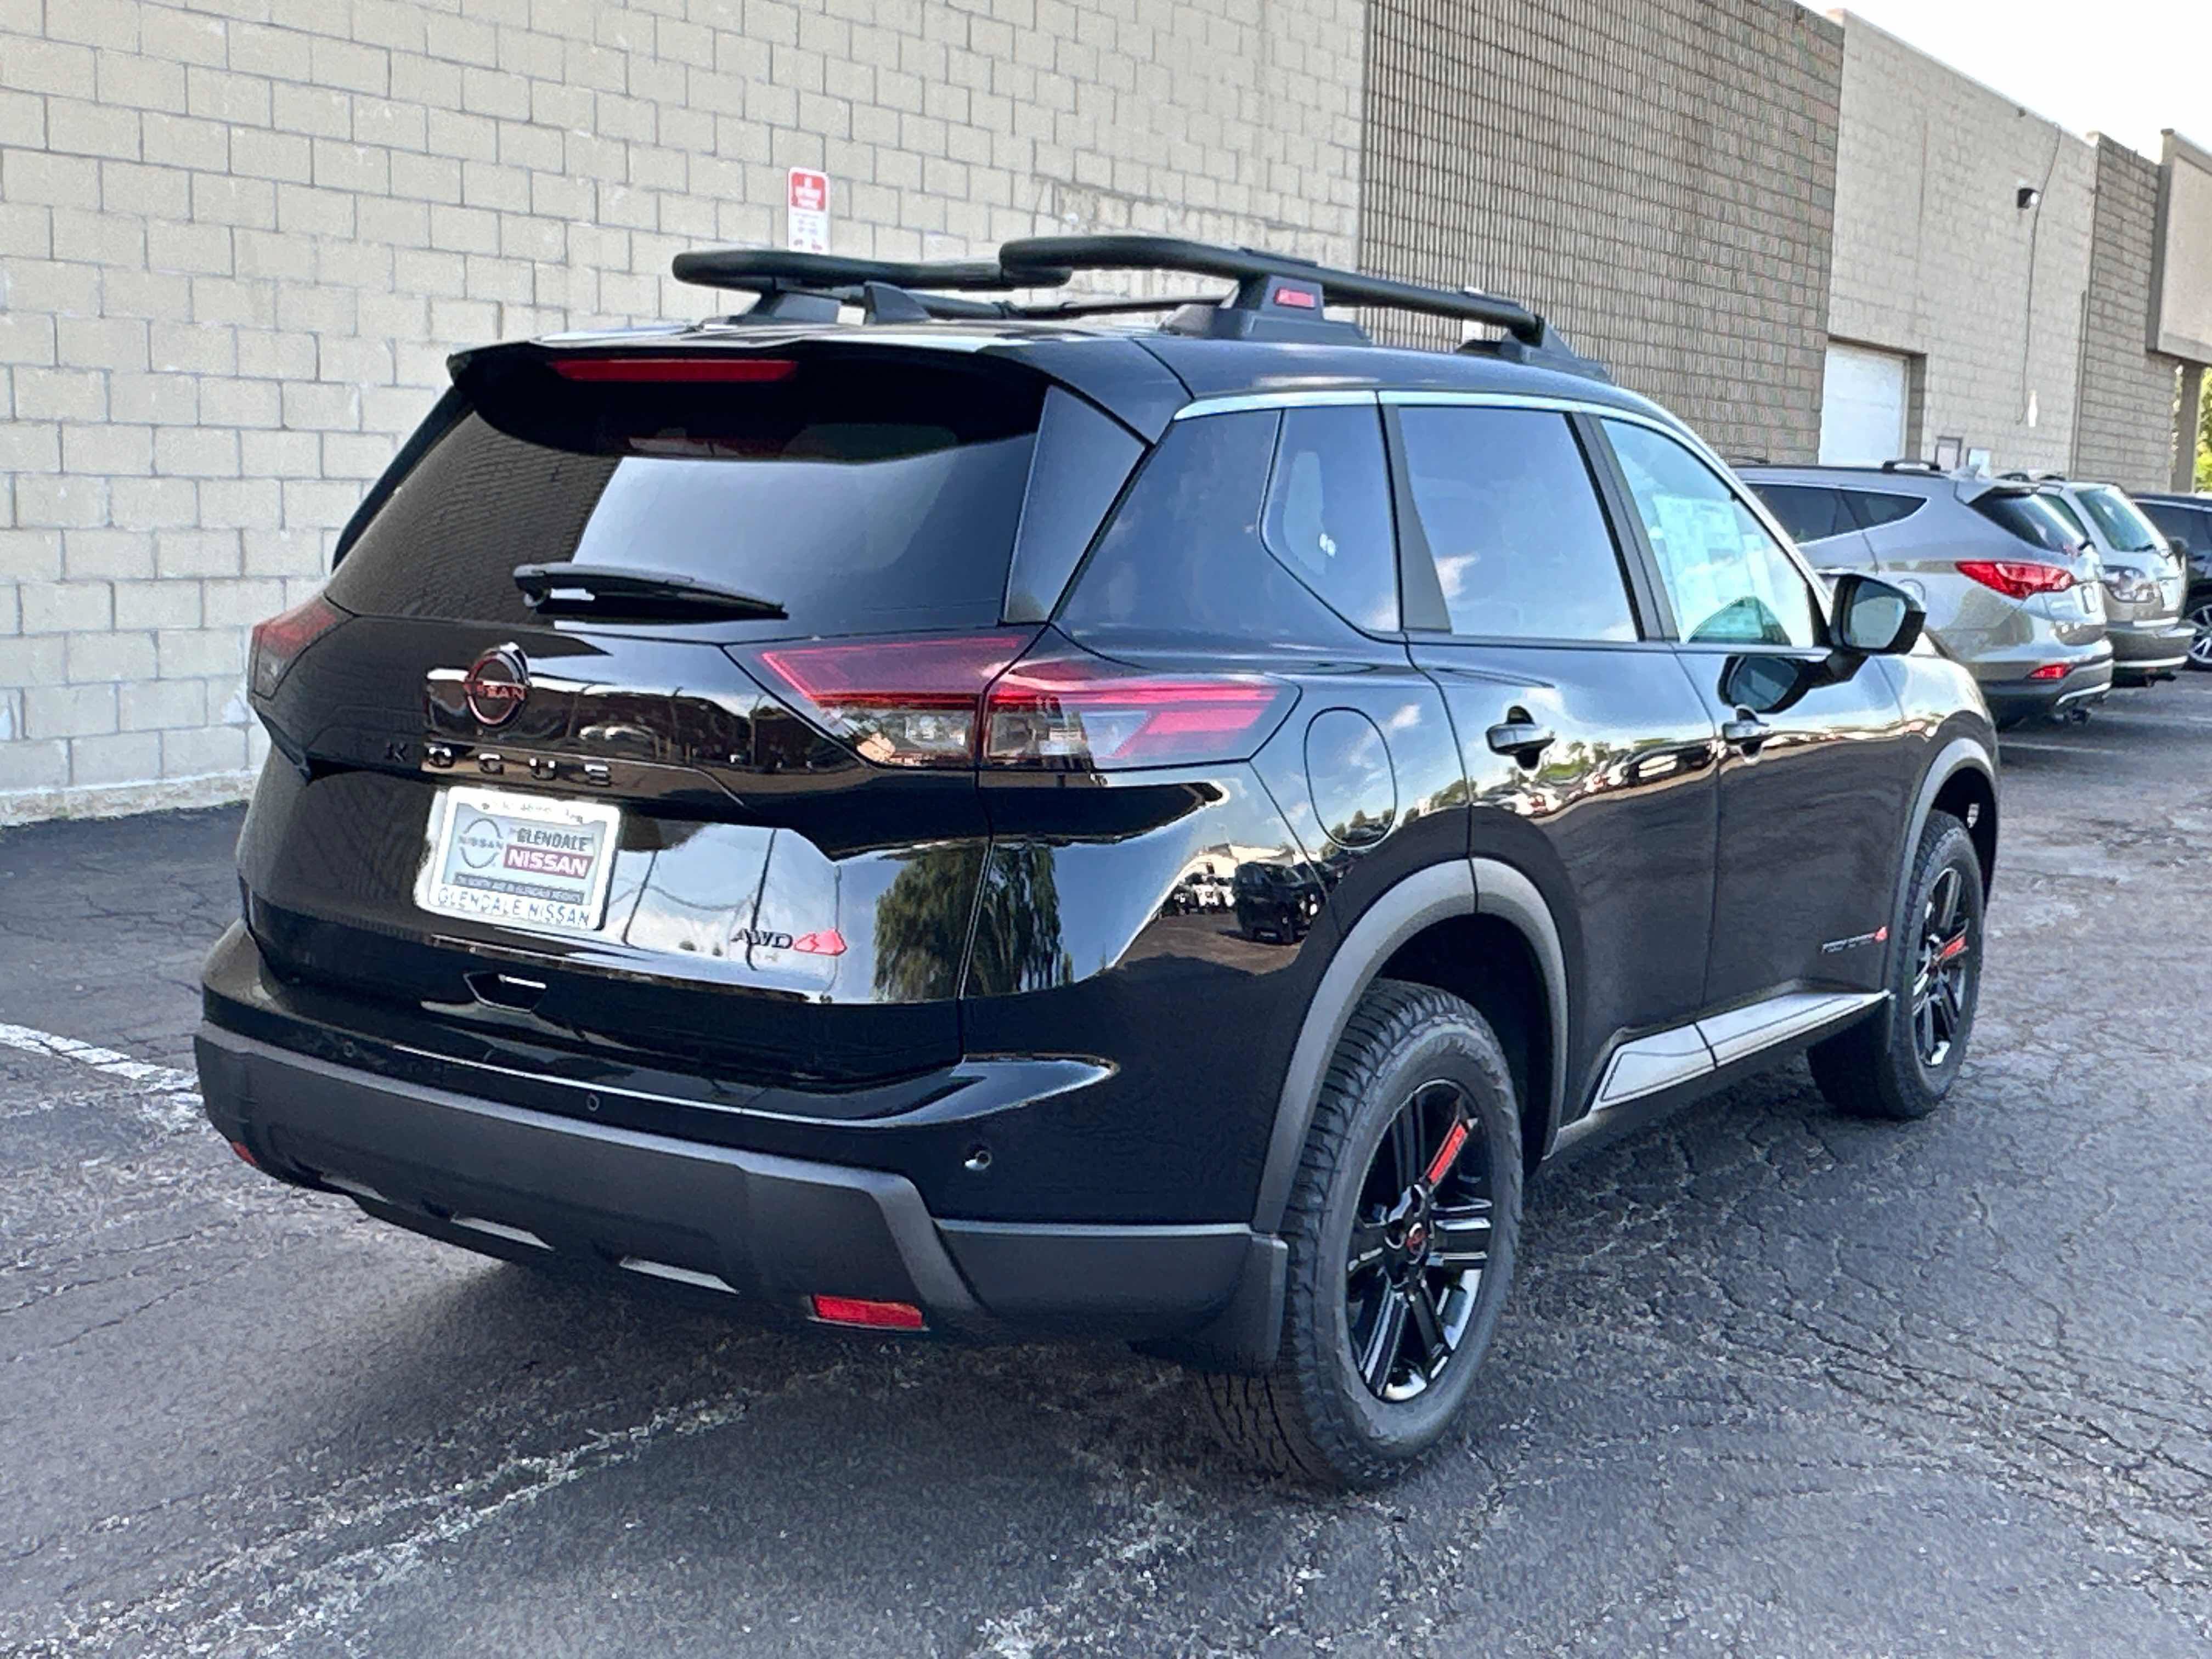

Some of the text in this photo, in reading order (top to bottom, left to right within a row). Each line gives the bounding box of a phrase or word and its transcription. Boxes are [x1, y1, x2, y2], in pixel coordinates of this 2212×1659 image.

[517, 827, 588, 851] GLENDALE
[507, 849, 588, 877] NISSAN
[438, 887, 522, 915] GLENDALE
[528, 905, 590, 926] NISSAN
[731, 928, 793, 949] AWD
